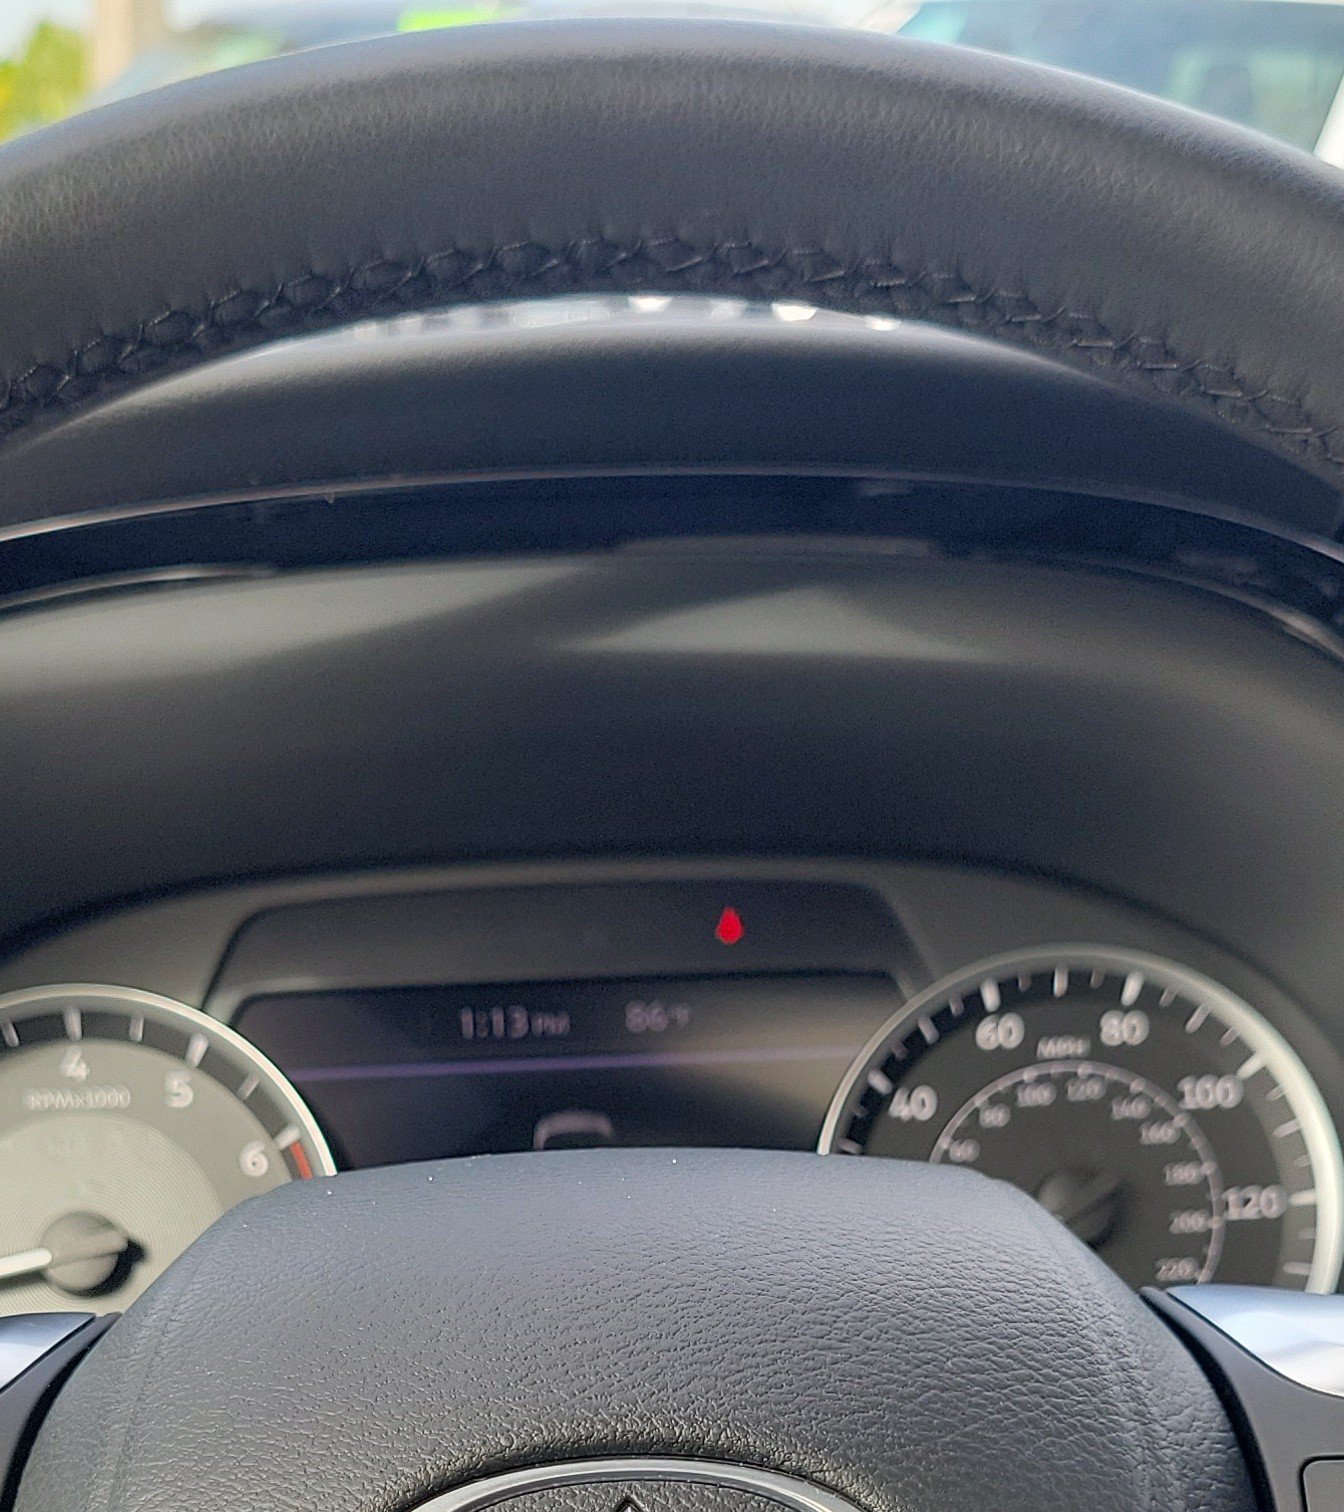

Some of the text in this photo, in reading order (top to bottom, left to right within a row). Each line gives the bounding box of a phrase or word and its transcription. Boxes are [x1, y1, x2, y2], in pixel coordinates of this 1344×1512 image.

[975, 1012, 1025, 1050] 60
[1100, 1010, 1151, 1047] 80
[61, 1050, 90, 1082] 4
[167, 1070, 195, 1108] 5
[888, 1084, 938, 1121] 40
[1178, 1074, 1244, 1110] 100
[240, 1146, 269, 1178] 6
[1222, 1184, 1289, 1221] 120
